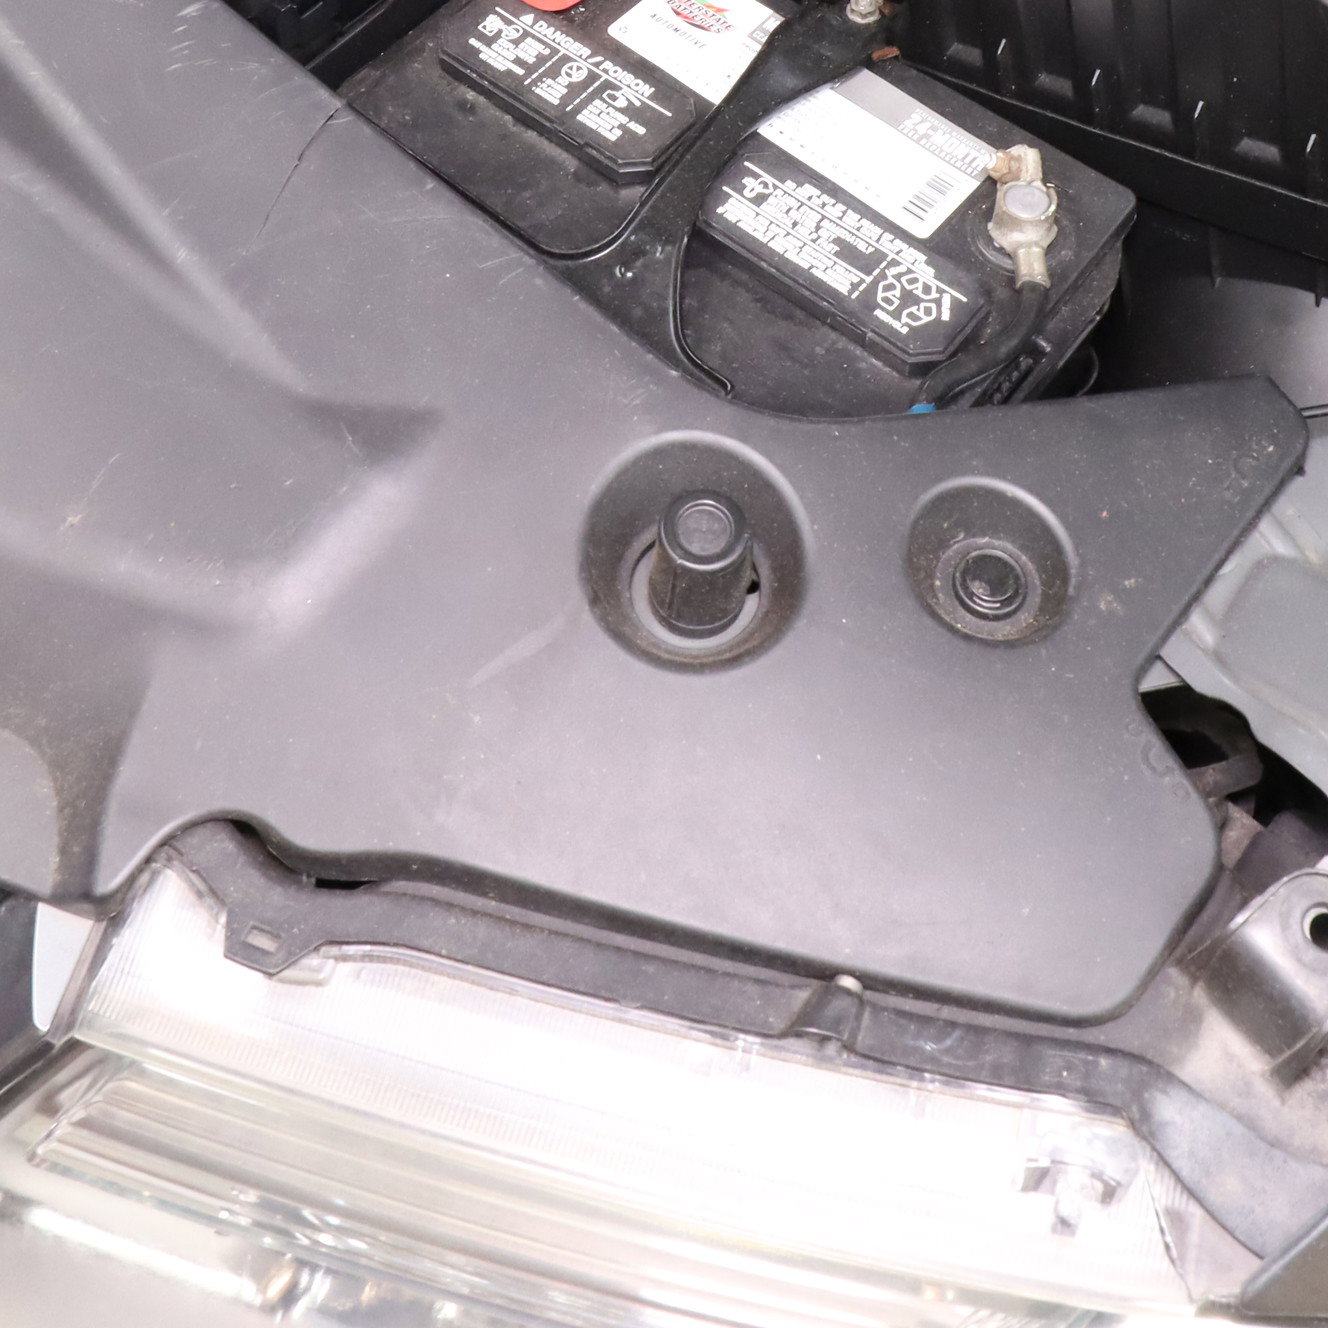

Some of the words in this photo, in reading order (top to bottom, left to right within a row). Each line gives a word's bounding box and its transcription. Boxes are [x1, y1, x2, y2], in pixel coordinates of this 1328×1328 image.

[532, 20, 592, 59] DANGER
[599, 60, 656, 98] POISON
[650, 13, 707, 49] AUTOMOTIVE
